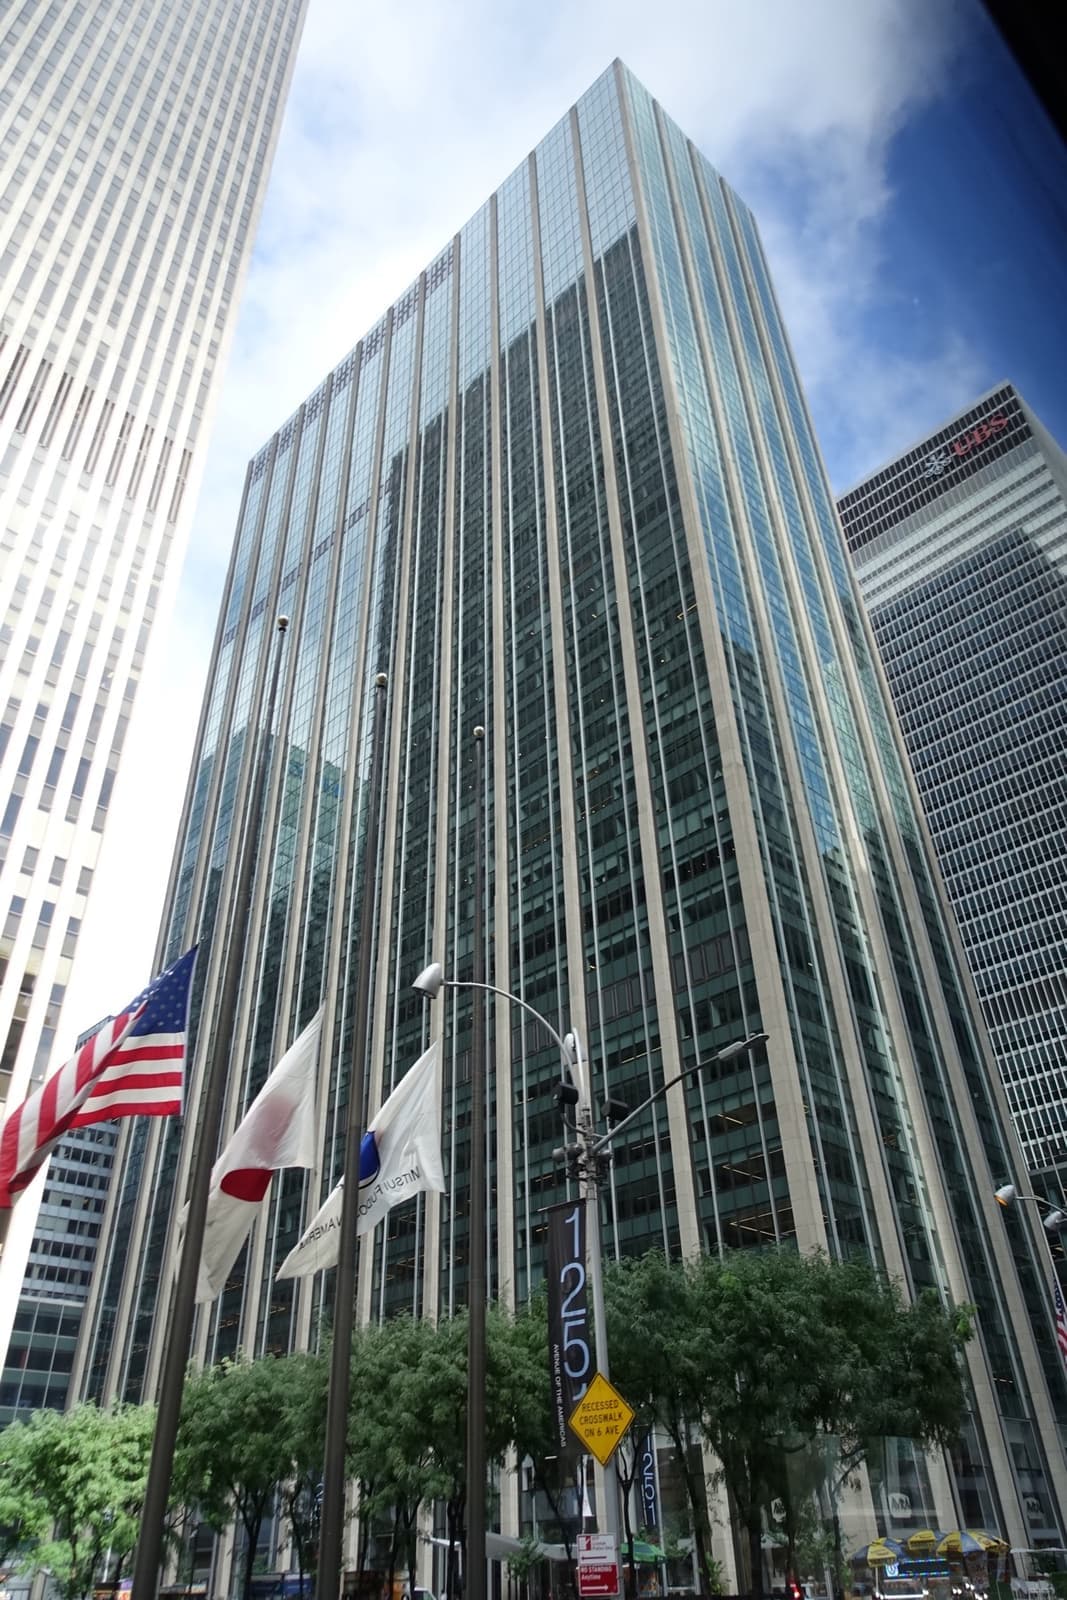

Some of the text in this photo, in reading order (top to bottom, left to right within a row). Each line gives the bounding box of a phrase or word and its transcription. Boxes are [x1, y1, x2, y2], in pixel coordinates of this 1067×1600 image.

[953, 411, 1008, 456] UBS
[560, 1207, 589, 1400] 125
[552, 1343, 560, 1375] AVENUE
[555, 1375, 561, 1387] OF
[579, 1411, 623, 1426] CROSSWALK
[582, 1399, 619, 1412] RECESSED
[558, 1405, 567, 1448] AMERICAS
[584, 1424, 620, 1438] ON 6 AVE
[642, 1433, 656, 1526] 1251
